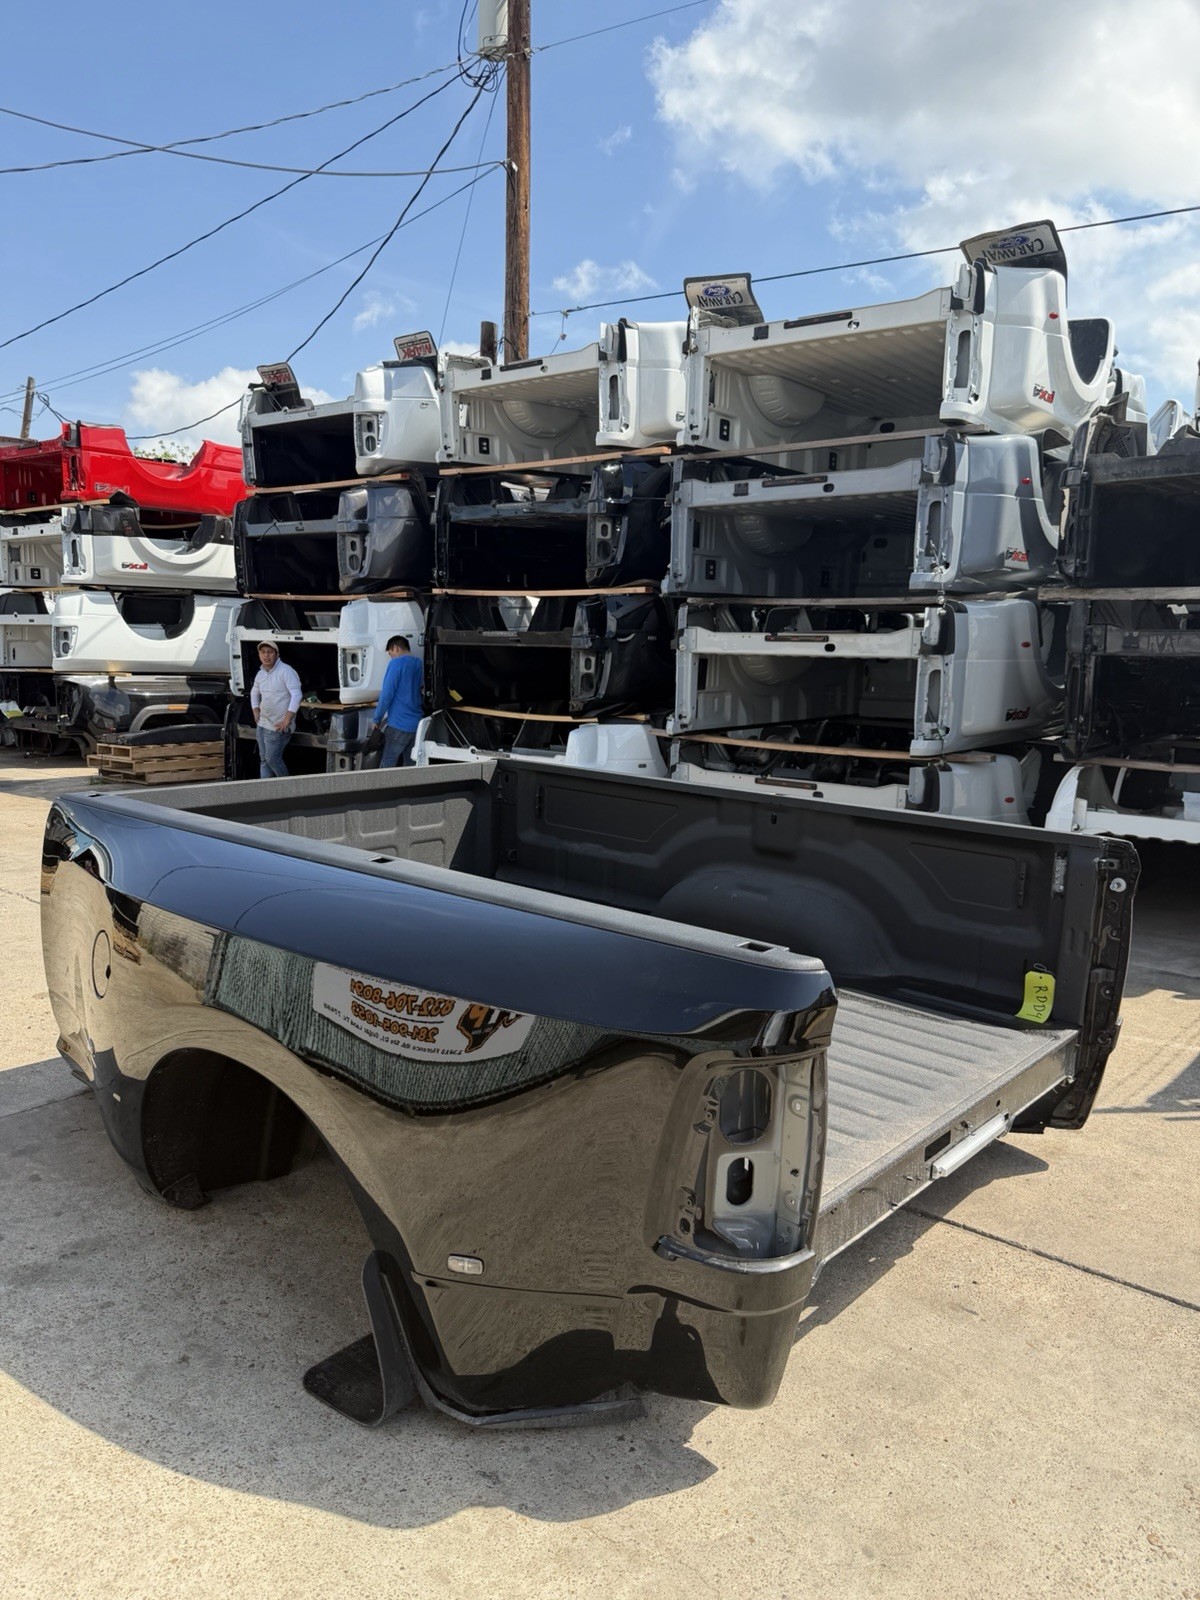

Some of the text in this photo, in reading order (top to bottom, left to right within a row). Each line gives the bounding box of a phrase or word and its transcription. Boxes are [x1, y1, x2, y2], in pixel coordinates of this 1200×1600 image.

[982, 238, 1044, 262] CARAWAY
[697, 291, 743, 307] CARAWAY
[1026, 984, 1049, 1019] RDD4
